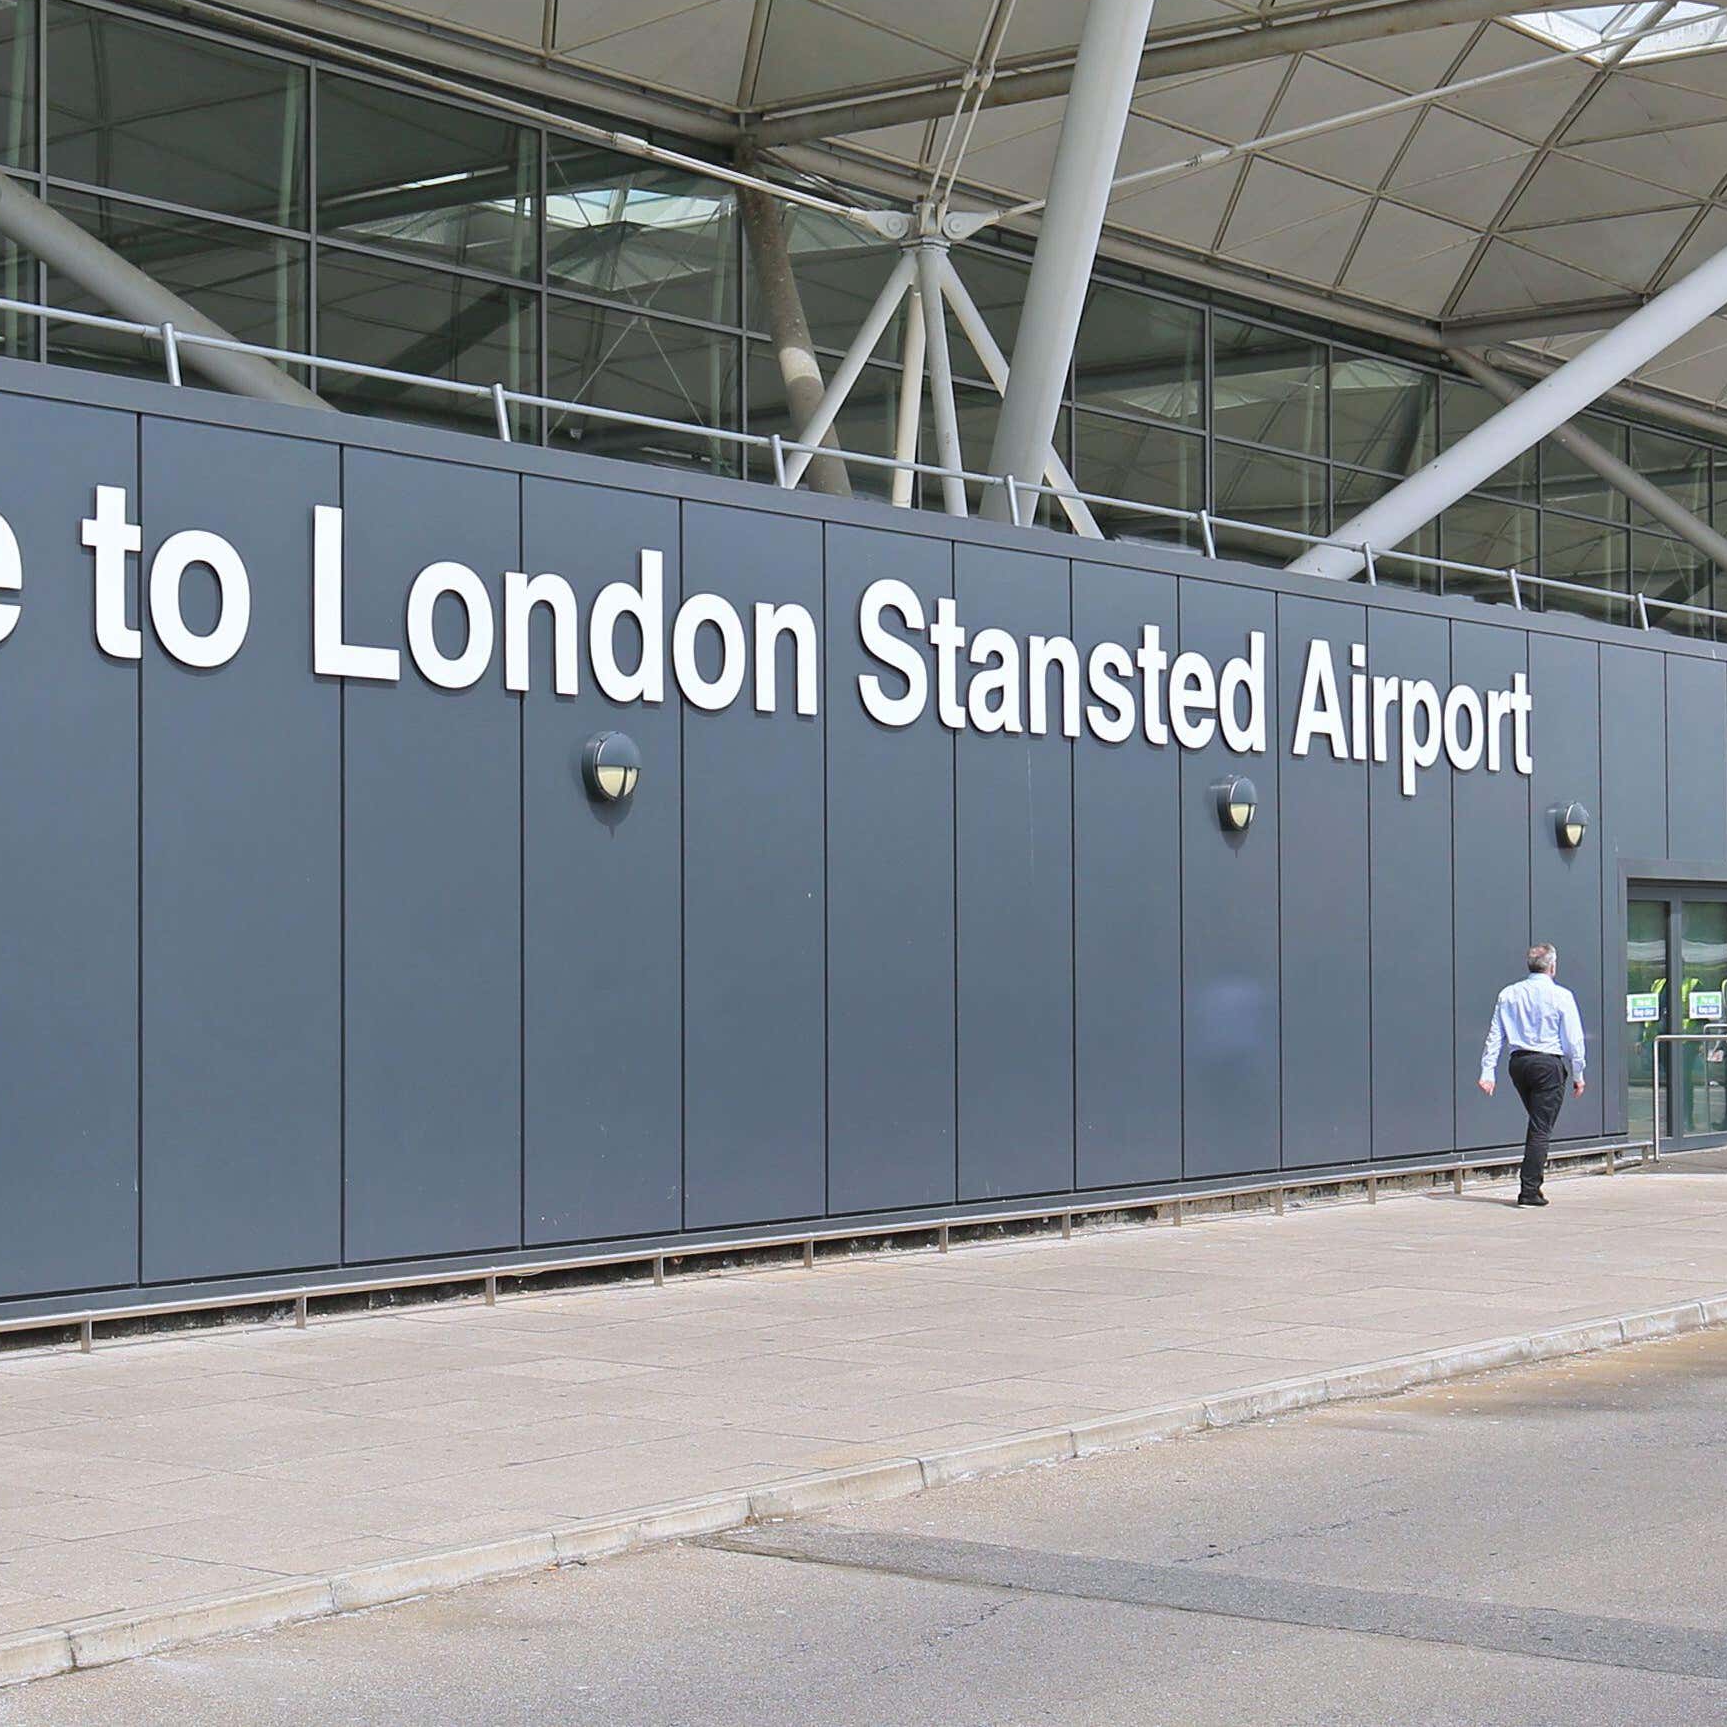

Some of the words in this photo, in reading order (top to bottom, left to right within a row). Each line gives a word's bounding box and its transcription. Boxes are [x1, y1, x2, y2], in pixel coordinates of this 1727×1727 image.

[82, 484, 251, 667] to
[314, 504, 818, 716] London
[858, 579, 1266, 752] Stansted
[1292, 639, 1533, 796] Airport
